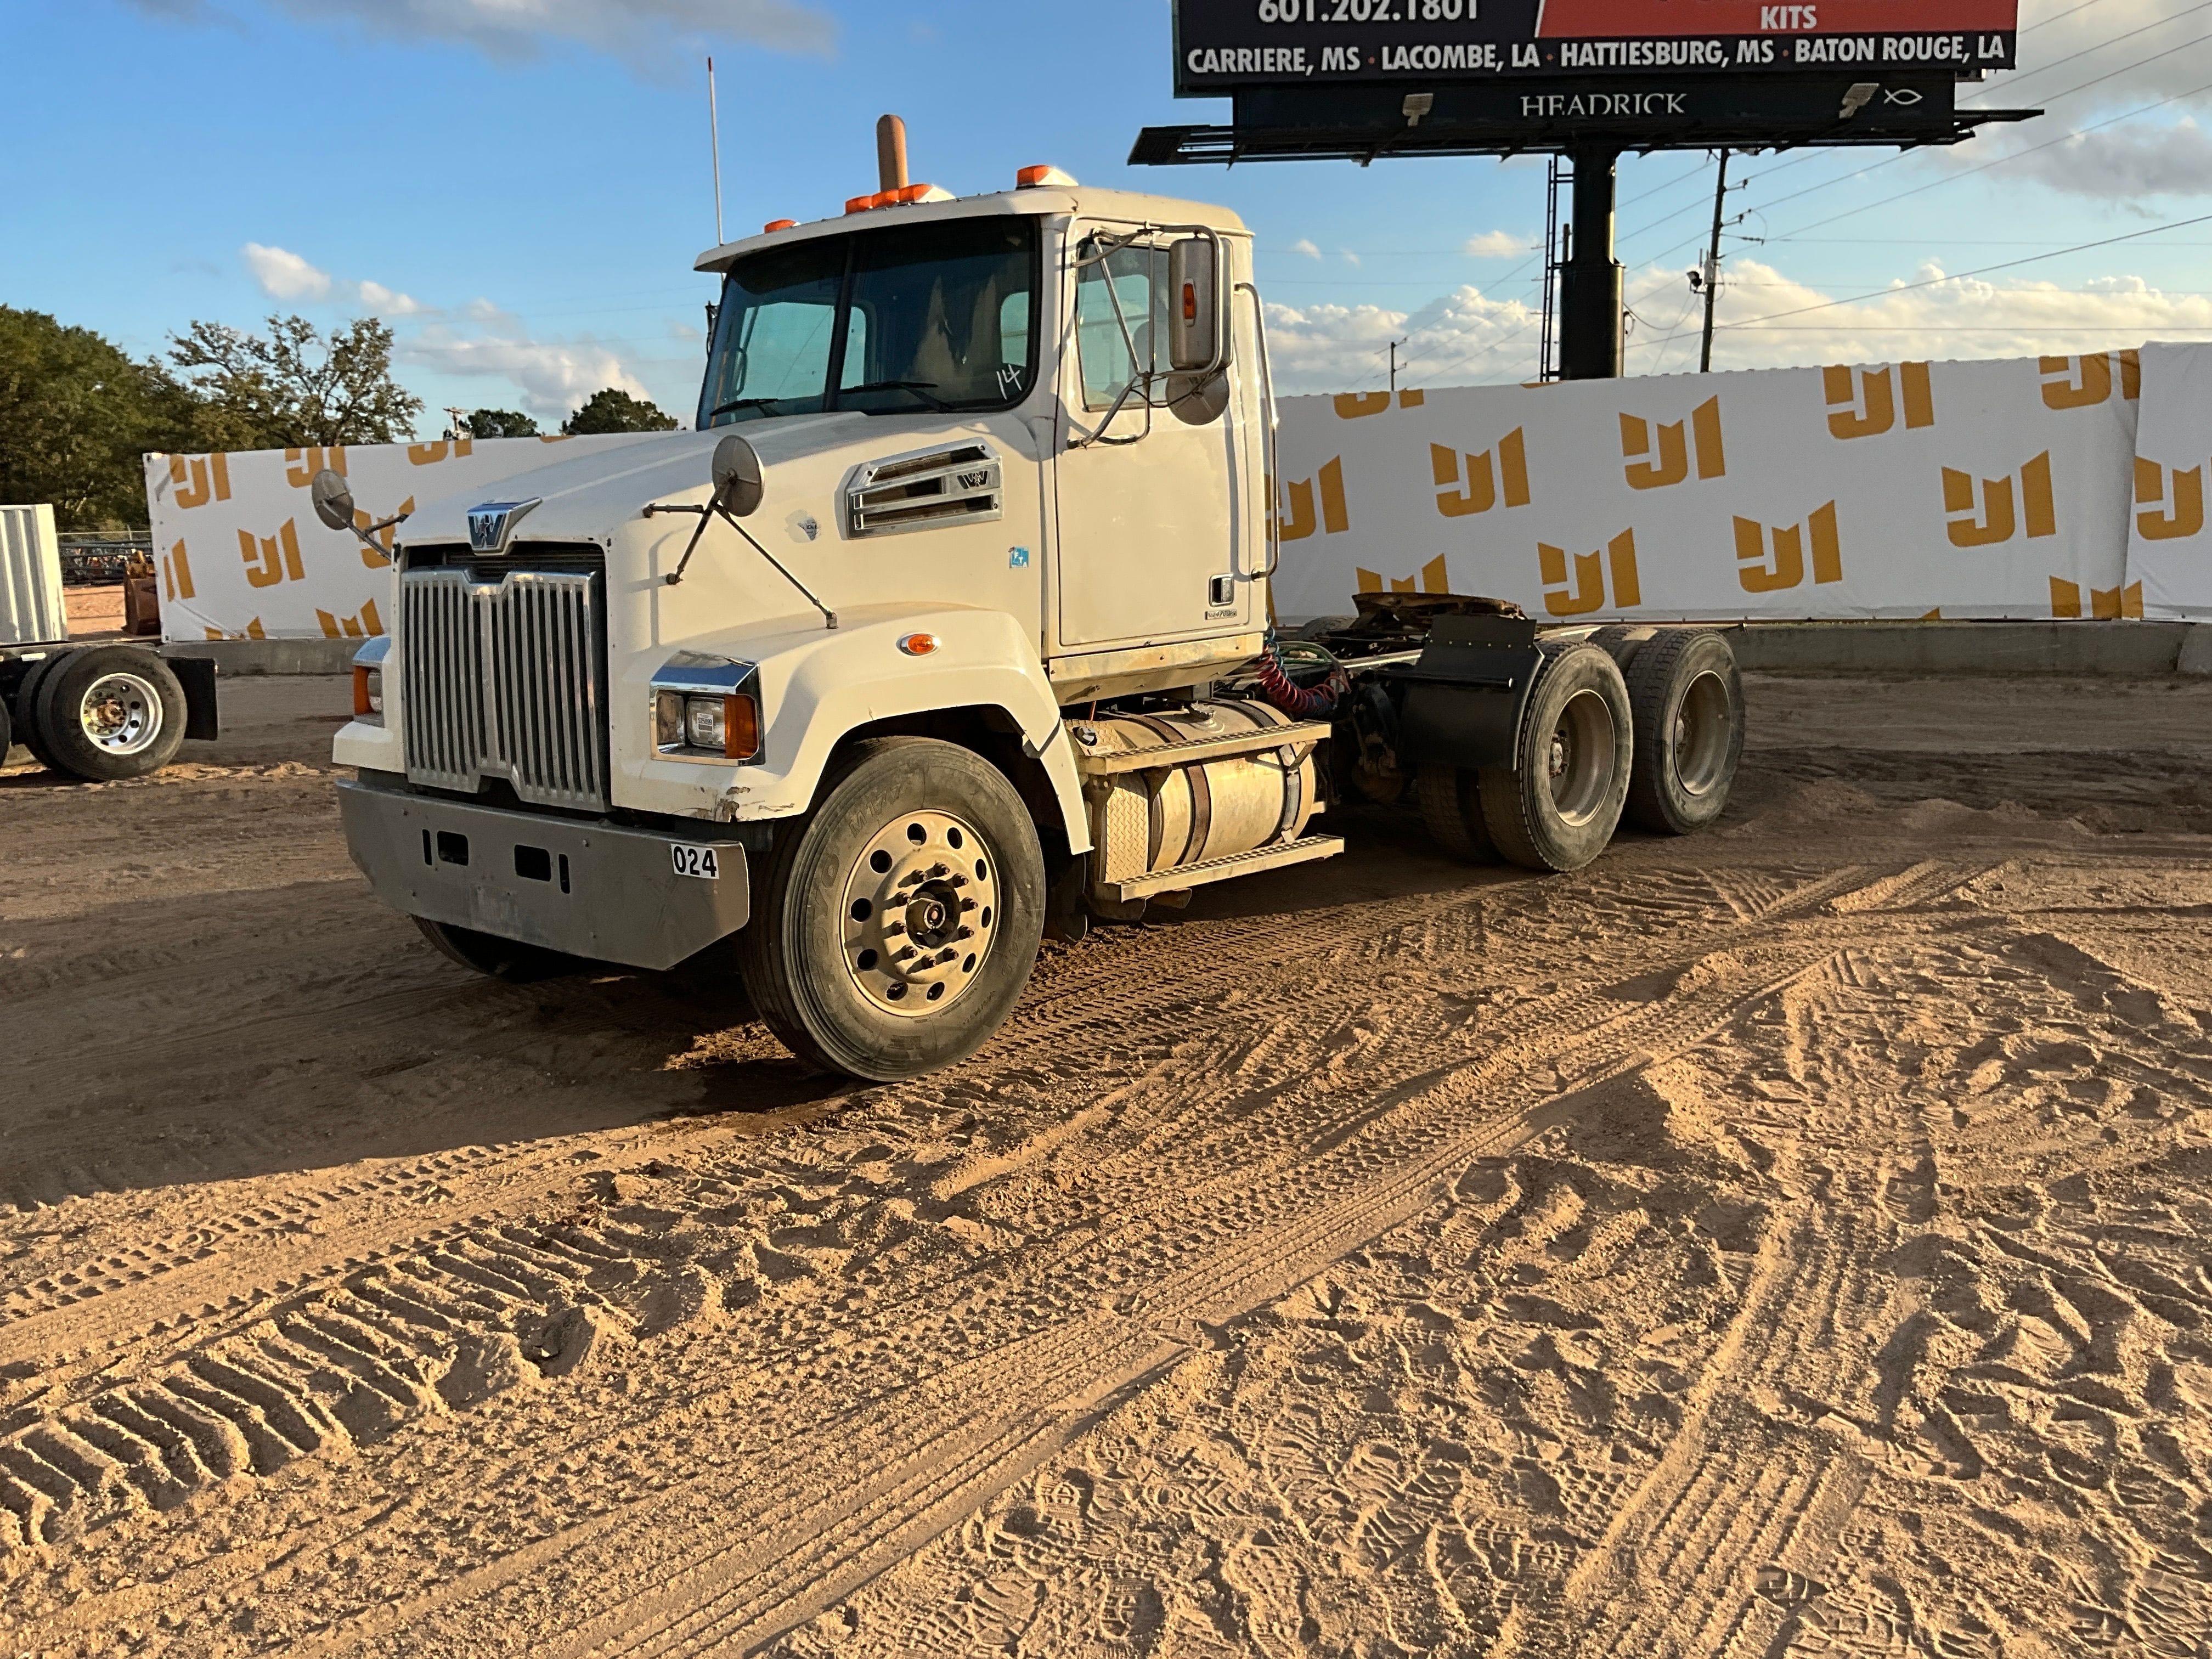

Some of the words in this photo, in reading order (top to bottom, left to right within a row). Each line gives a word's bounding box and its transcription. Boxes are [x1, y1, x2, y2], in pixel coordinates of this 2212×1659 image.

[1258, 0, 1477, 22] 601.202.1801
[1760, 5, 1817, 30] KITS
[1187, 48, 1314, 76] CARRIERE,
[1321, 47, 1361, 71] MS
[1381, 44, 1504, 73] LACOMBE,
[1511, 44, 1540, 67] LA
[1561, 40, 1729, 68] HATTIESBURG,
[1736, 40, 1774, 64] MS
[1795, 37, 1875, 64] BATON
[1882, 36, 1970, 64] ROUGE,
[1978, 36, 2005, 58] LA
[1520, 93, 1688, 116] HEADRICK
[996, 364, 1022, 400] 14
[673, 846, 716, 877] 024
[812, 854, 839, 992] TOYO
